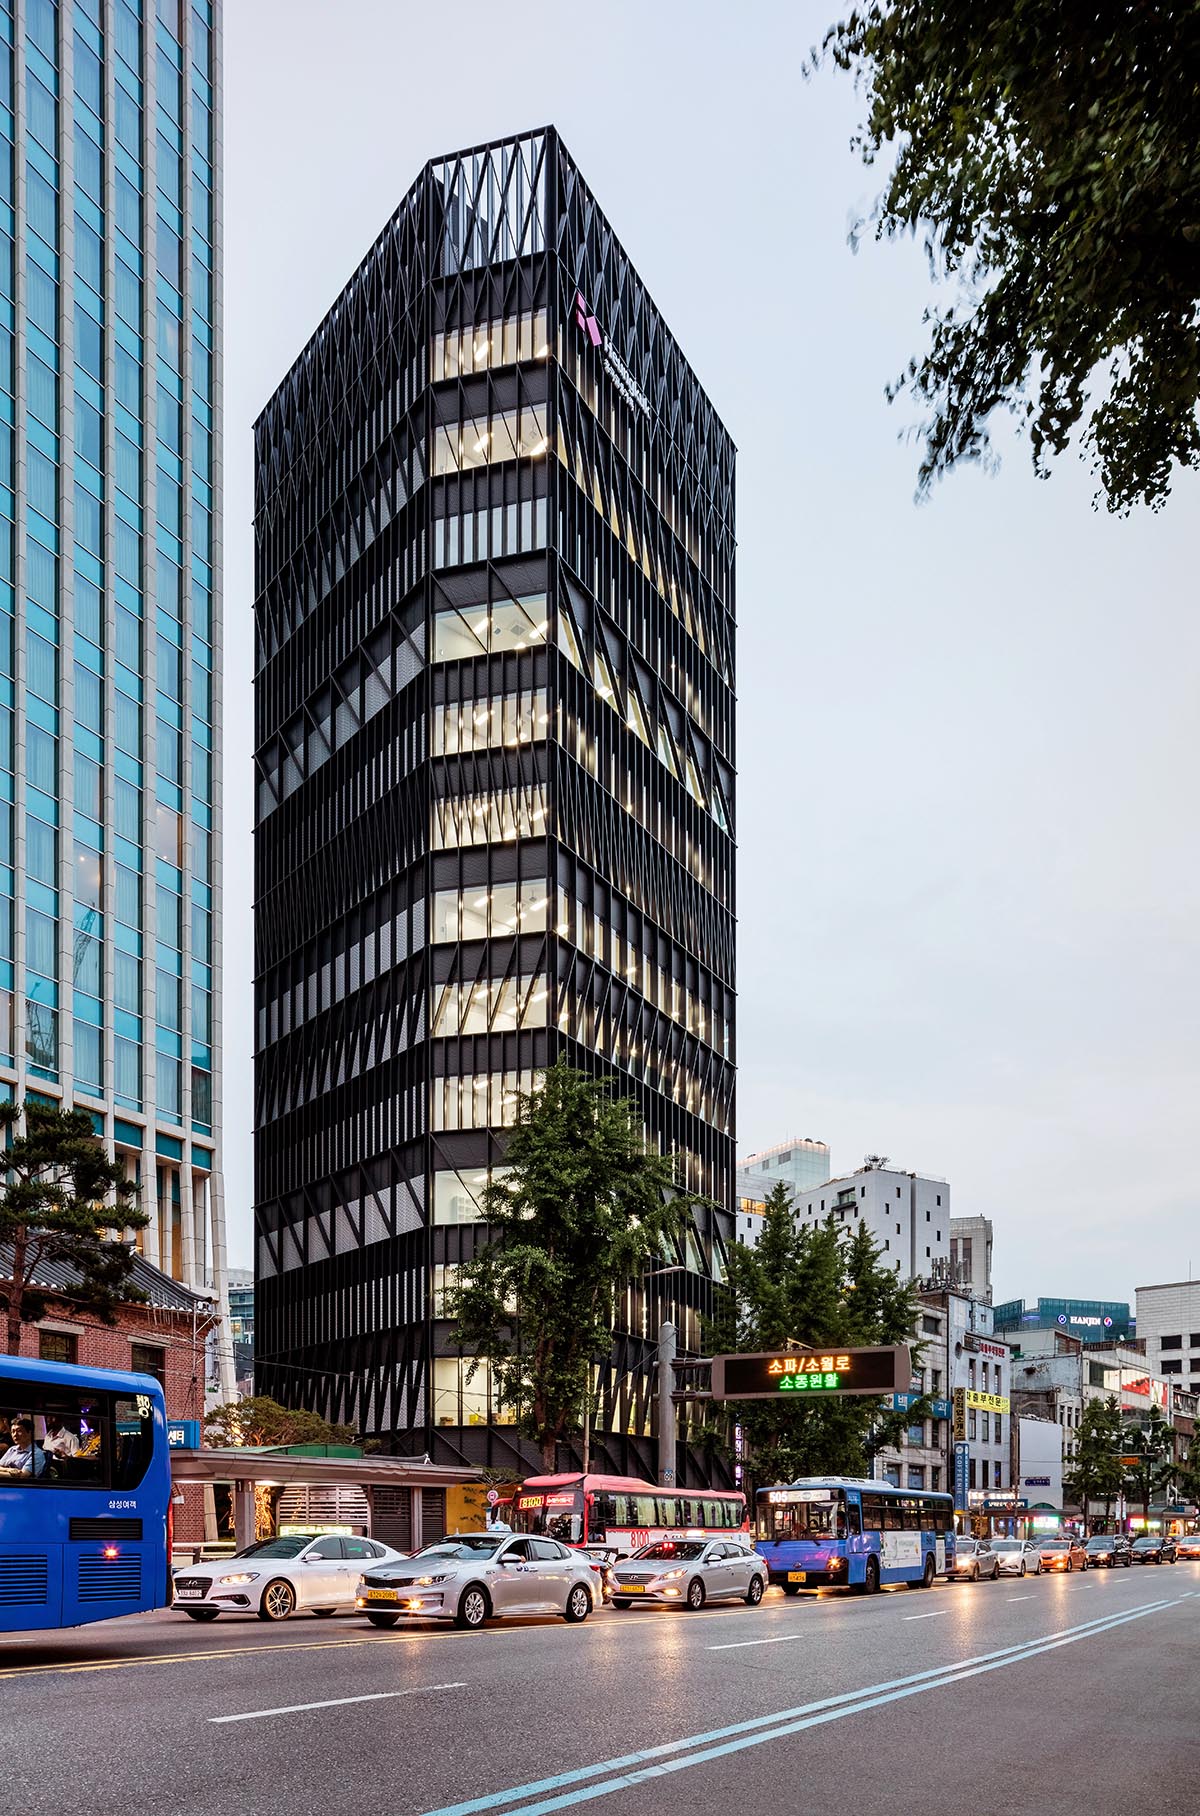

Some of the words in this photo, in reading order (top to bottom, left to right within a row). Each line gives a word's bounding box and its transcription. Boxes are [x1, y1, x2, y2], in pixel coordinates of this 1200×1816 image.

[1070, 1316, 1101, 1327] HANJIN
[768, 1356, 851, 1374] 소파/소월로
[522, 1496, 542, 1508] 8100
[769, 1491, 788, 1503] 505
[108, 1500, 137, 1509] 삼성여객
[630, 1532, 650, 1548] 8100
